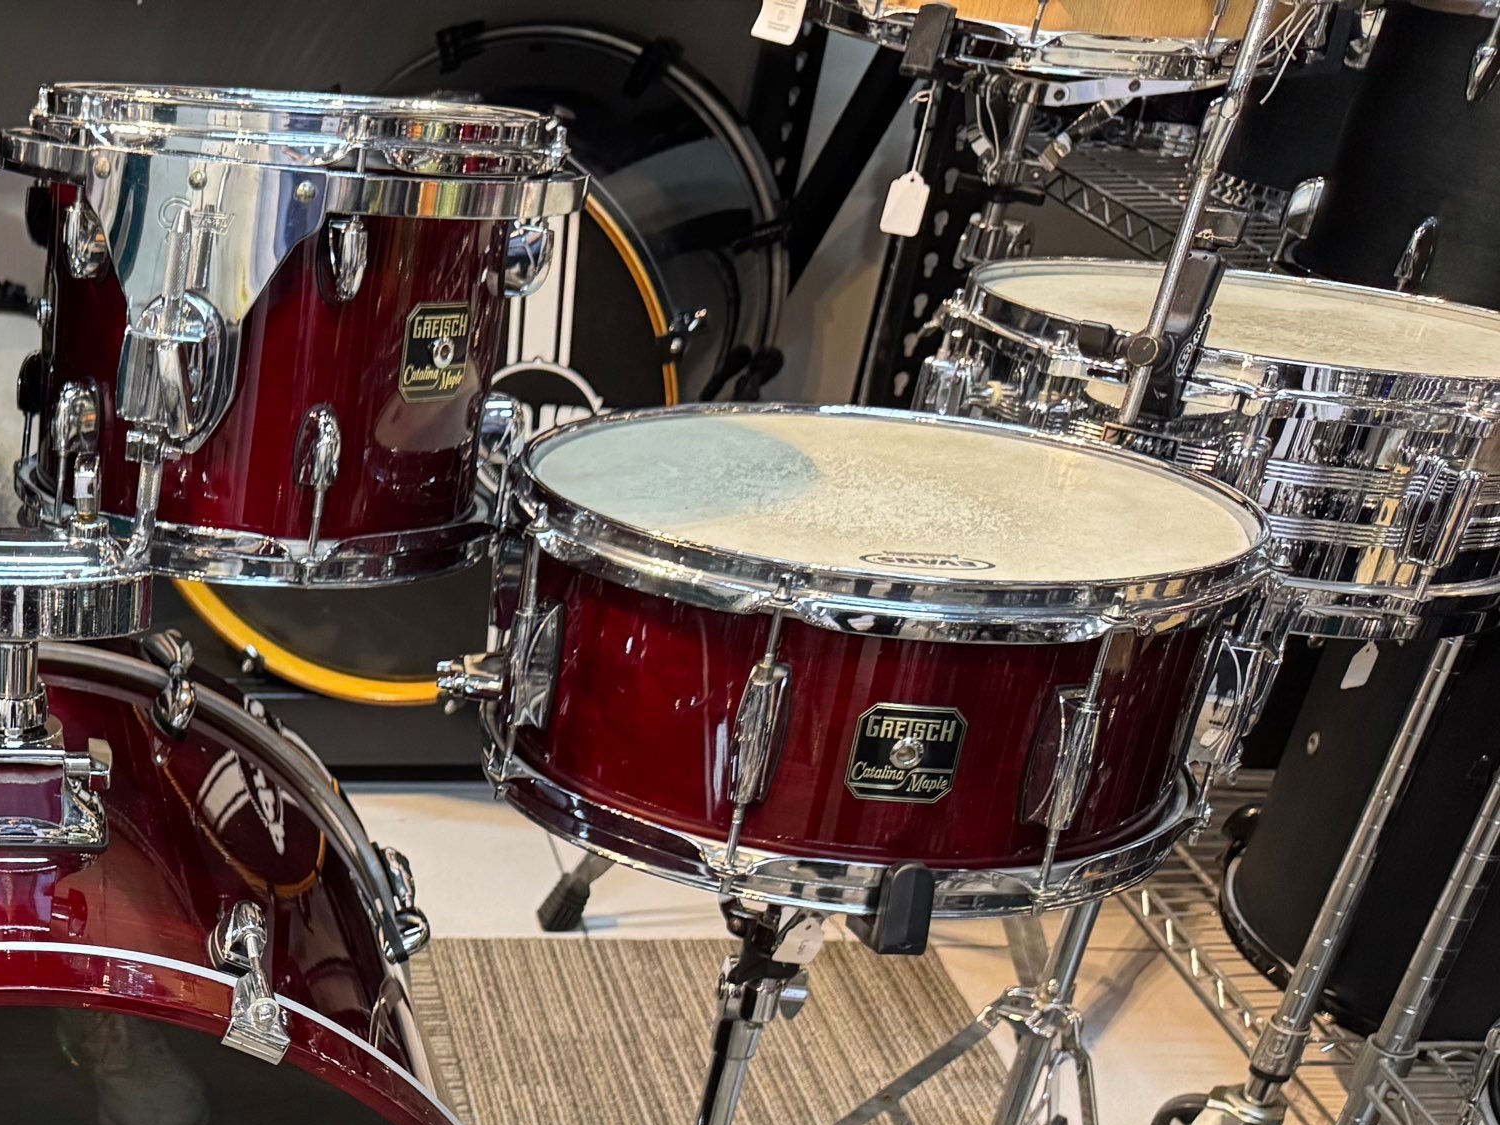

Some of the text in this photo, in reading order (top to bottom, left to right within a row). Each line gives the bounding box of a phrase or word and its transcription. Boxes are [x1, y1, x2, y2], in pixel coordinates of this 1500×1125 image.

[412, 312, 469, 340] GRETSCH
[403, 363, 464, 391] Catalina Maple
[865, 714, 957, 742] GRETSCH
[851, 761, 948, 793] Catalina Maple
